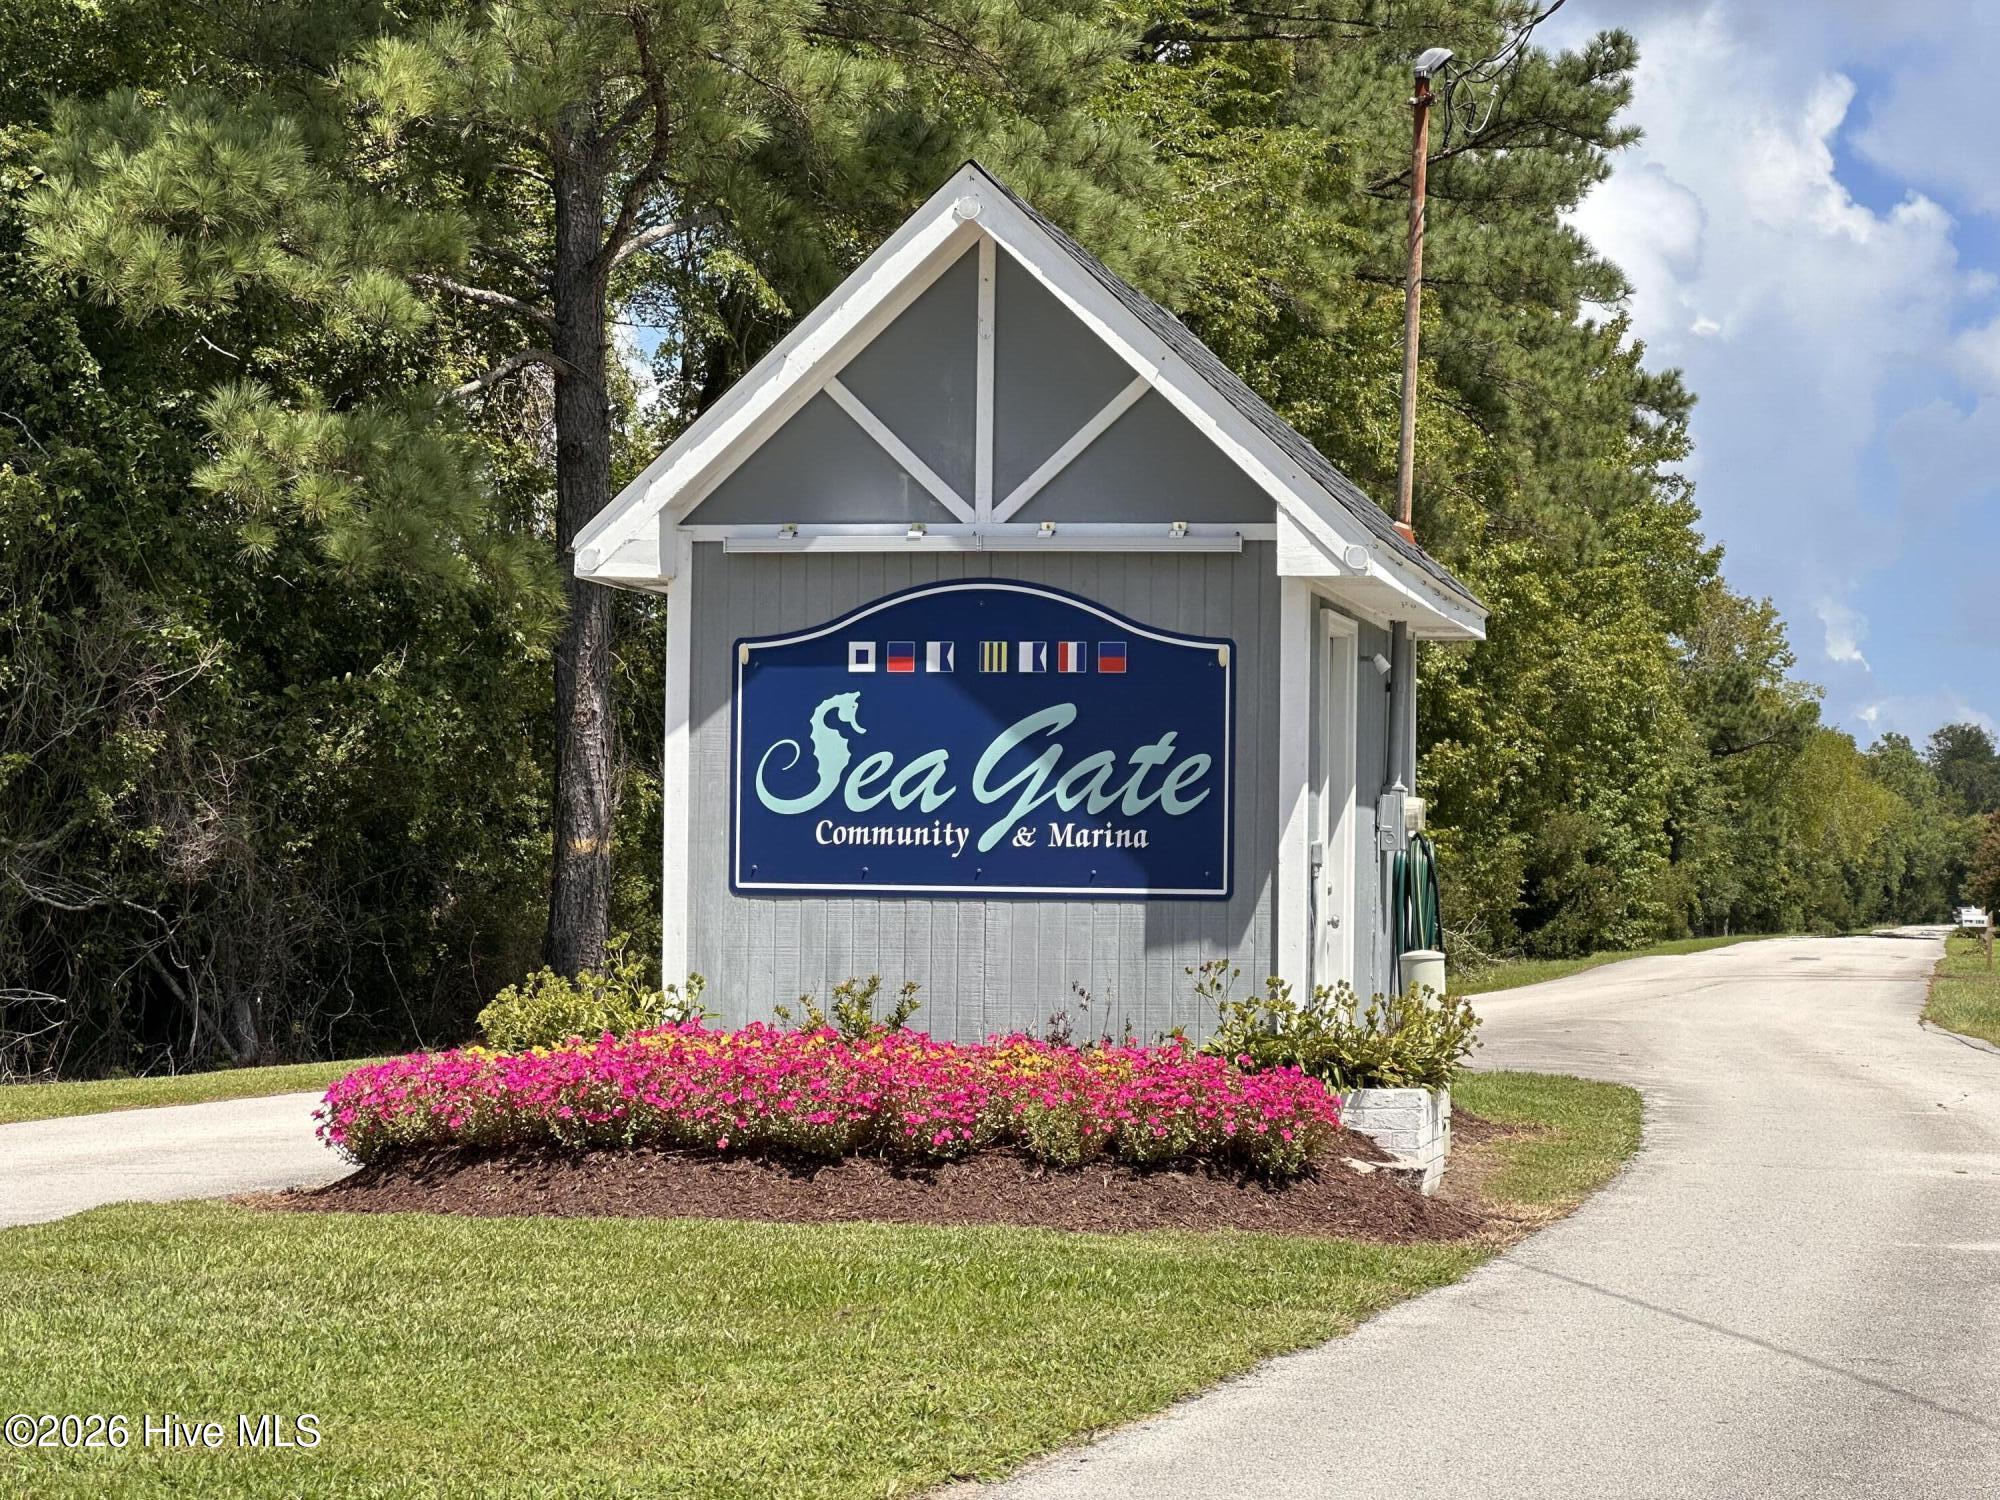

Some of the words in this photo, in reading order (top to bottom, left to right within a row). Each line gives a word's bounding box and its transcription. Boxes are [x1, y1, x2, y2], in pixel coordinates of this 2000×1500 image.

[755, 691, 956, 814] Sea
[972, 703, 1211, 852] Gate
[815, 820, 969, 857] Community
[1012, 827, 1036, 848] &
[1048, 822, 1149, 848] Marina
